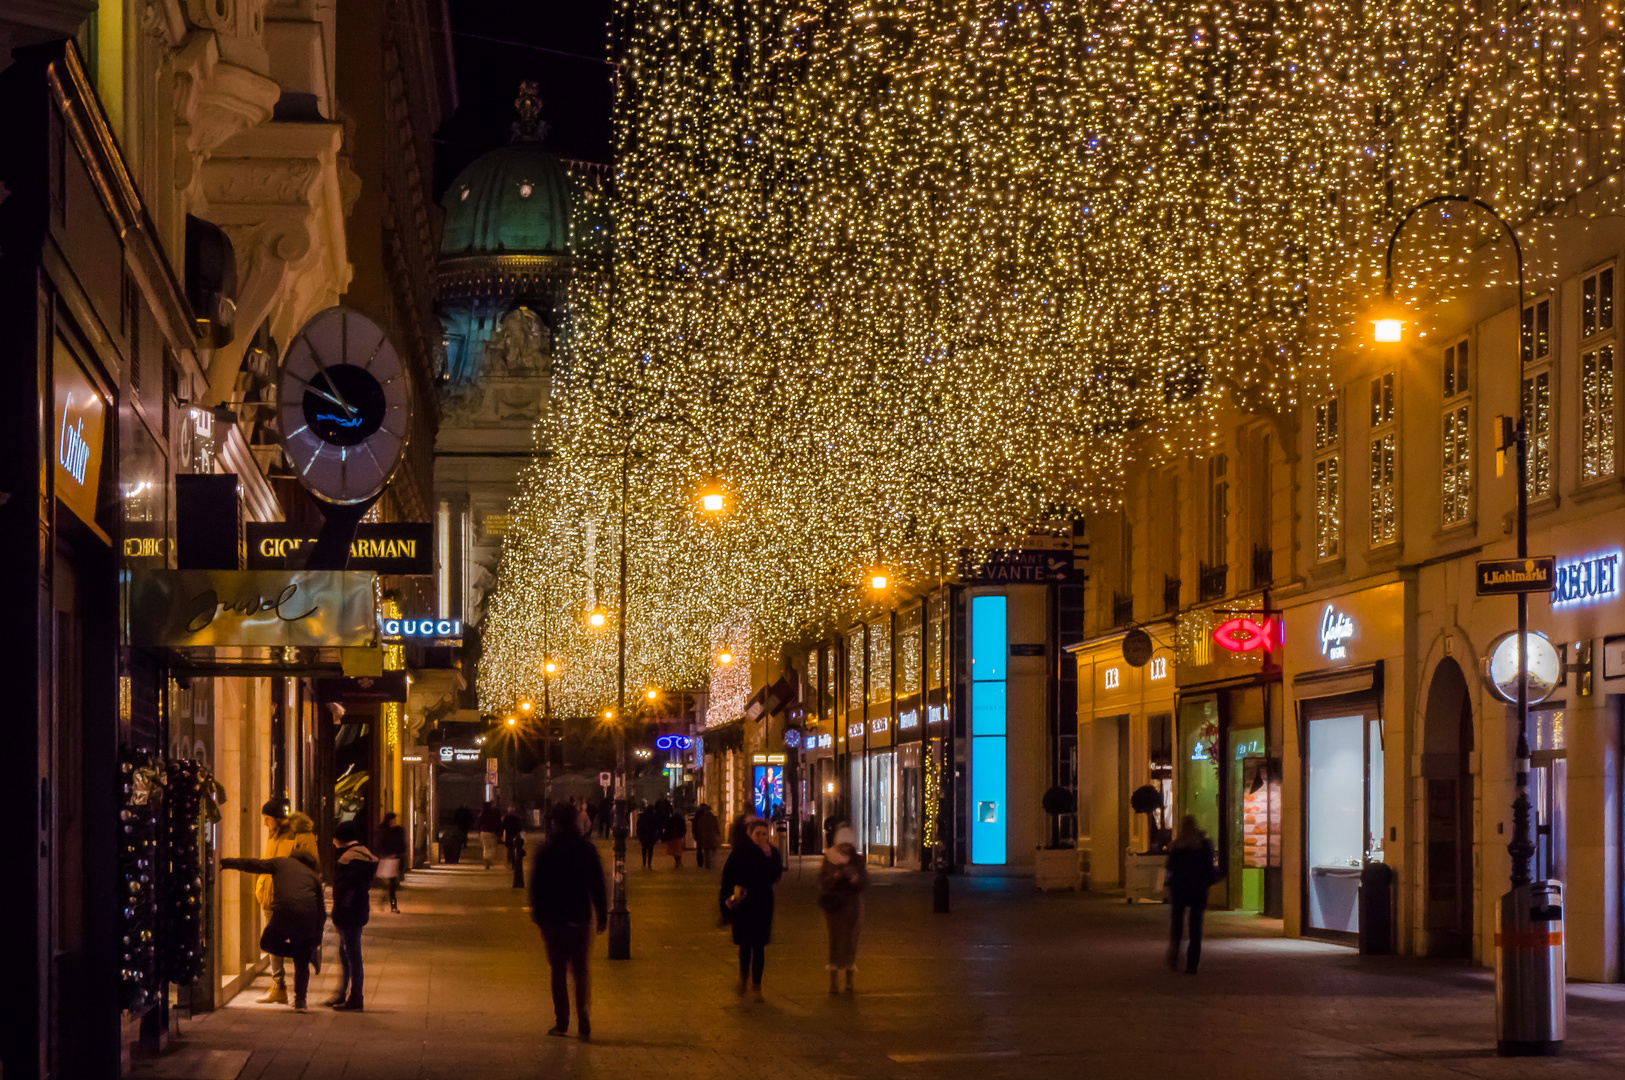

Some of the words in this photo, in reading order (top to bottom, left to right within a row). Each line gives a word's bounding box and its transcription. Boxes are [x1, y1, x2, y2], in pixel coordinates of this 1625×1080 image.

[60, 391, 89, 486] Cartier
[350, 539, 416, 558] ARMANI
[385, 619, 461, 636] GUCCI
